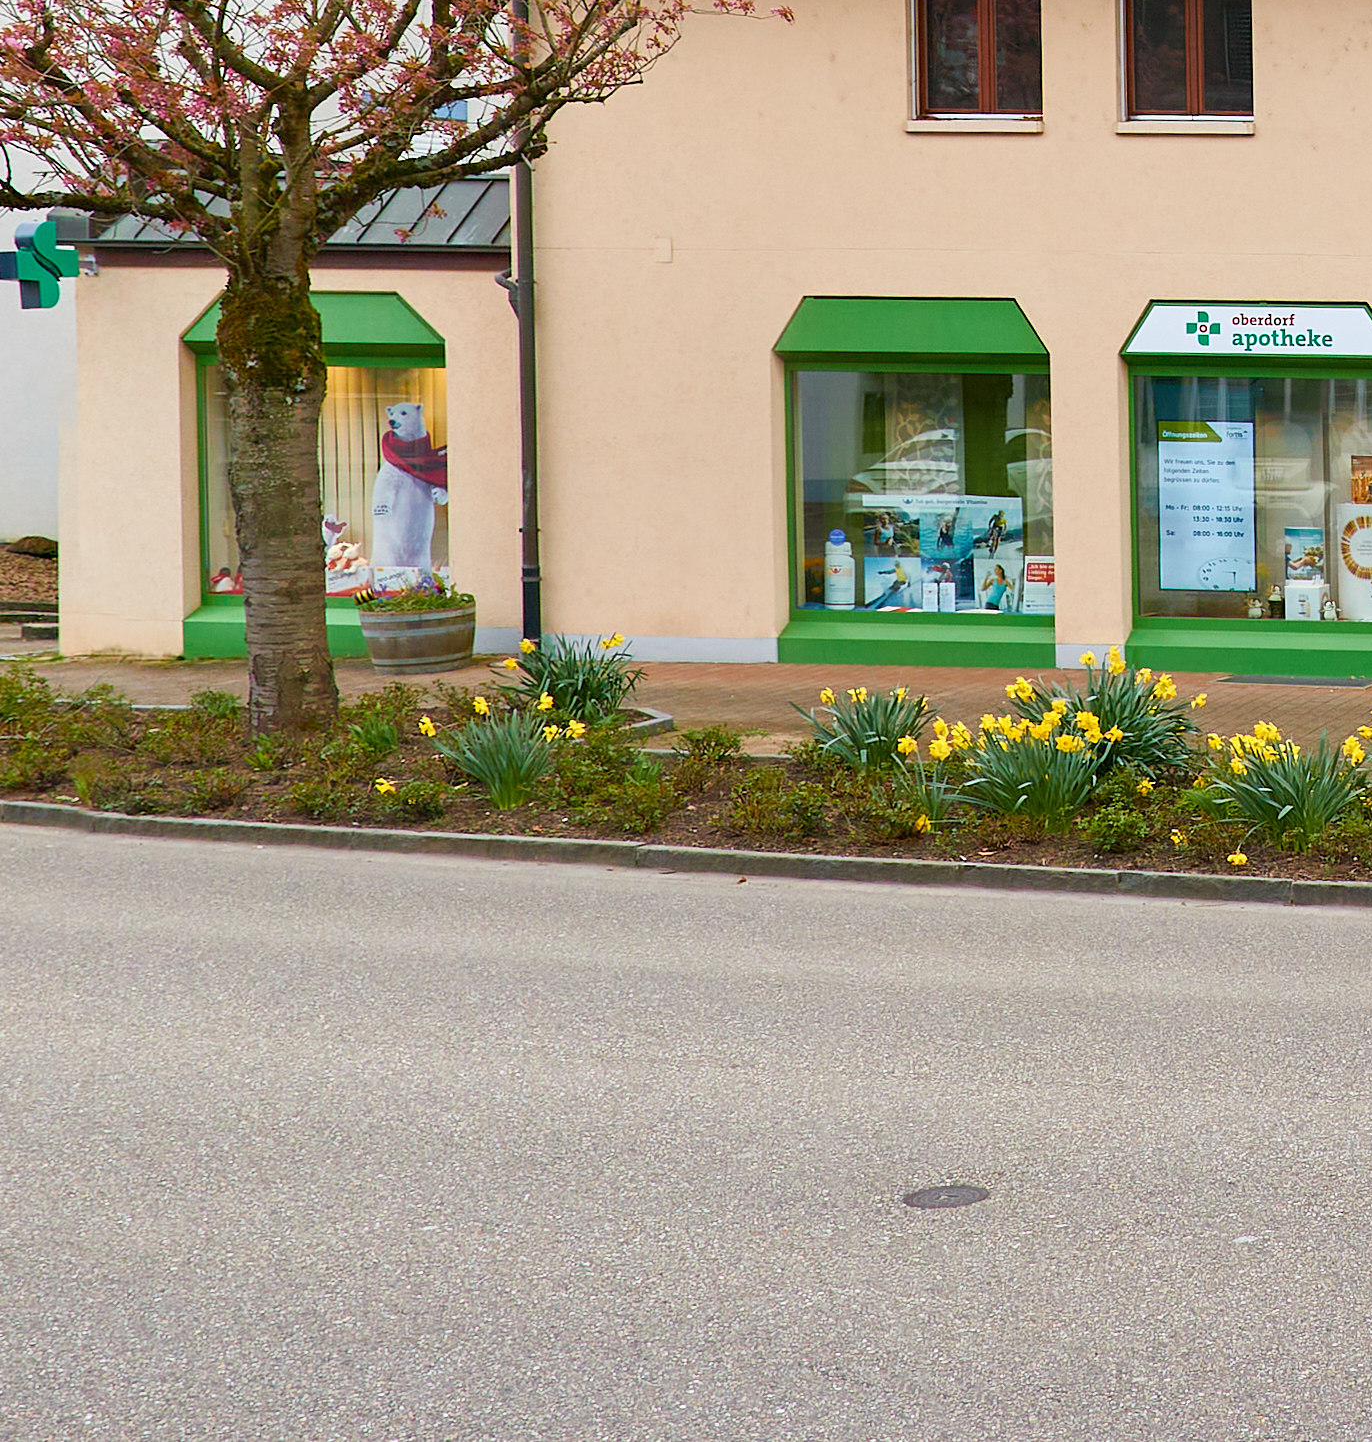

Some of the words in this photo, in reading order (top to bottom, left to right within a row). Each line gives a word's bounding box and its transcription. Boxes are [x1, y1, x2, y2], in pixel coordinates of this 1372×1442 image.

[1231, 313, 1295, 326] oberdorf
[1231, 328, 1333, 351] apotheke
[1162, 430, 1208, 440] Öffnungszeiten
